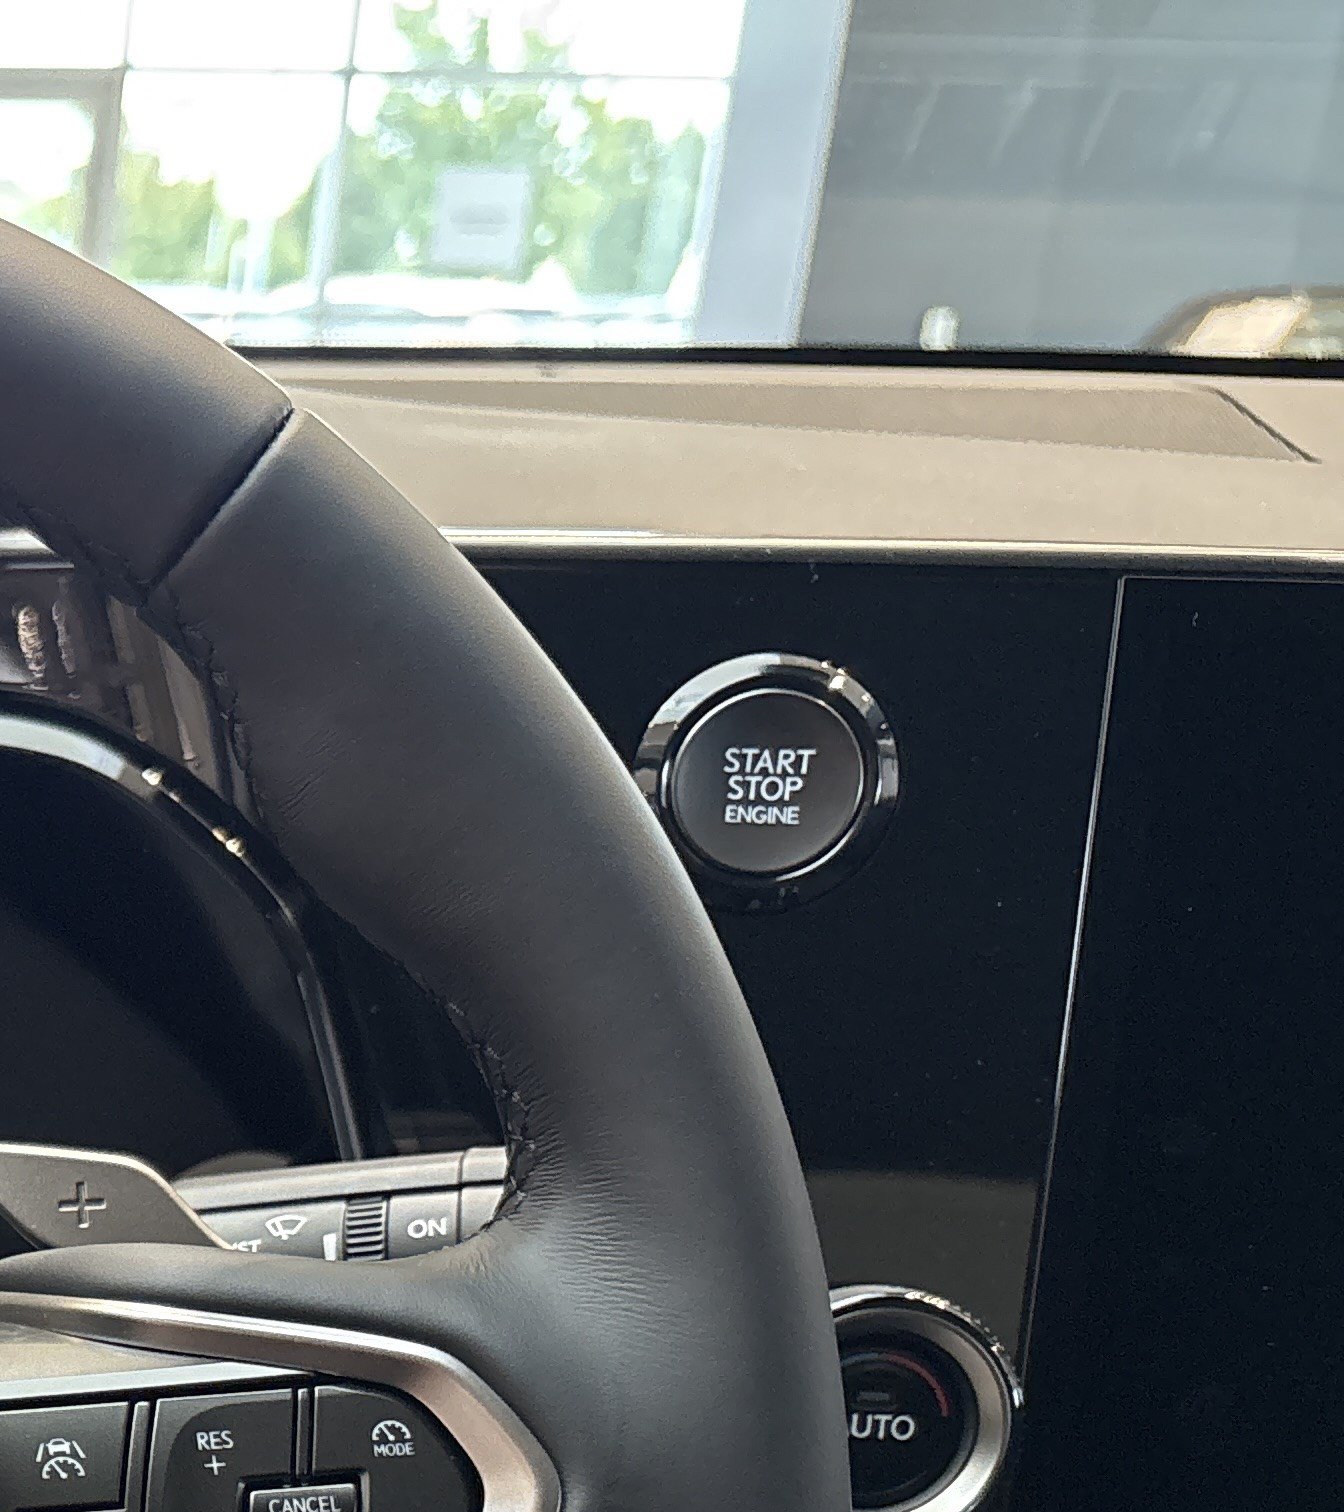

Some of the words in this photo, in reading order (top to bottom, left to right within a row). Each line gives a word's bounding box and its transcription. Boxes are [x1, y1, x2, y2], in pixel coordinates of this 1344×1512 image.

[723, 747, 817, 775] START
[726, 776, 804, 802] STOP
[724, 804, 801, 826] ENGINE
[407, 1217, 448, 1239] ON
[848, 1411, 915, 1441] UTO
[196, 1430, 235, 1450] RES
[373, 1442, 415, 1458] MODE
